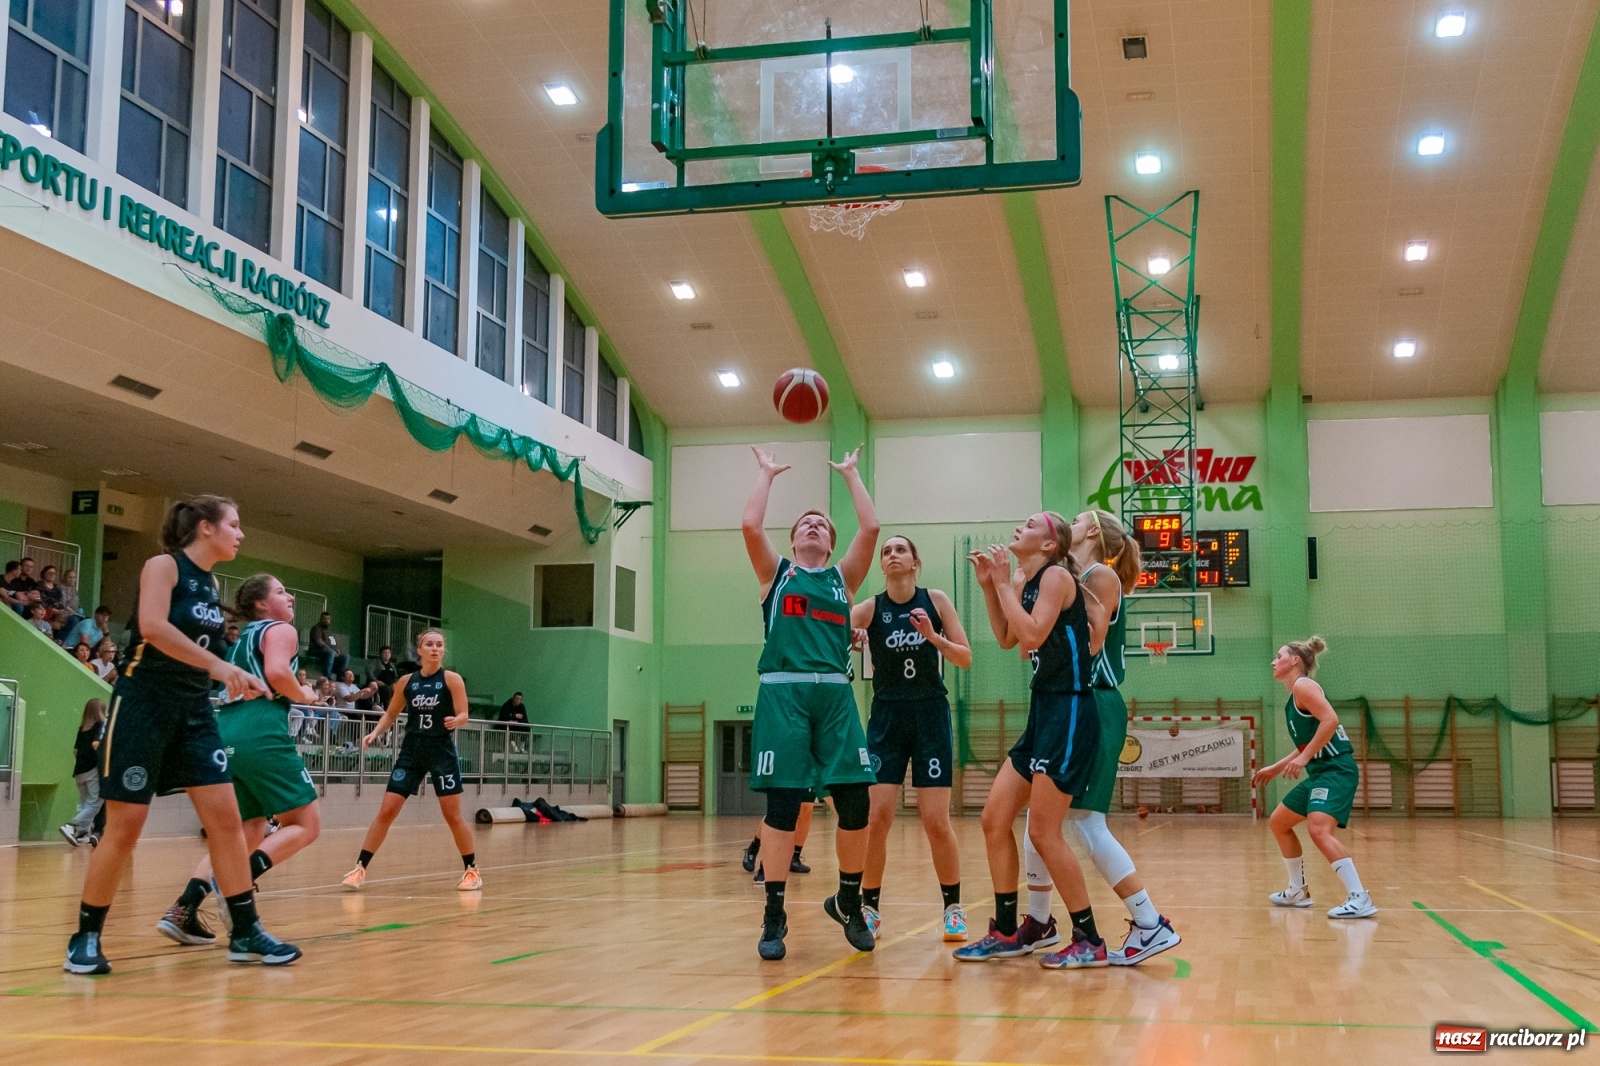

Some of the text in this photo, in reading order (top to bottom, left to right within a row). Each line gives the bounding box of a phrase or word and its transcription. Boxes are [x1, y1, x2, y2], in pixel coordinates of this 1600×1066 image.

[0, 129, 330, 329] PORTU I REKREACJI RACIBÓRZ
[79, 499, 92, 511] F
[1160, 532, 1170, 547] 9
[1199, 571, 1219, 583] 41
[904, 658, 916, 679] 8
[411, 693, 440, 707] Stal
[419, 714, 433, 730] 13
[213, 748, 228, 773] 9
[756, 750, 775, 776] 10
[928, 757, 942, 779] 8
[1148, 756, 1170, 770] JEST
[1171, 753, 1181, 762] W
[439, 774, 456, 790] 13
